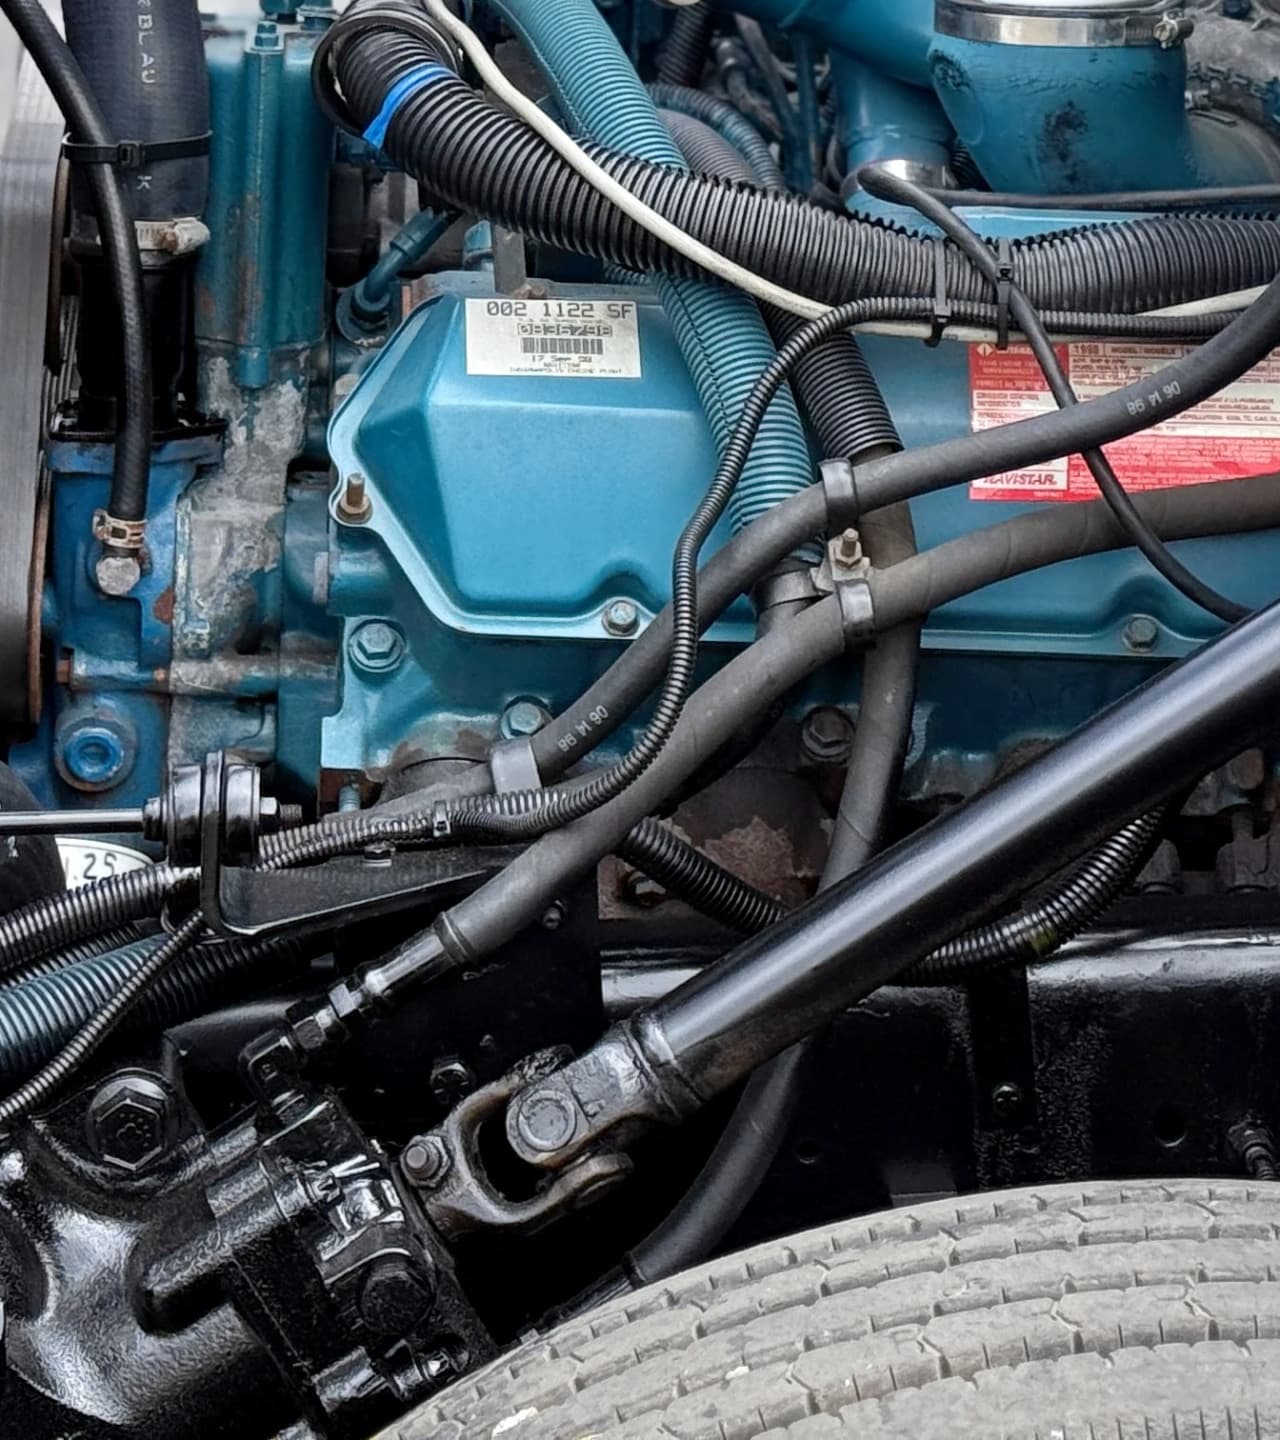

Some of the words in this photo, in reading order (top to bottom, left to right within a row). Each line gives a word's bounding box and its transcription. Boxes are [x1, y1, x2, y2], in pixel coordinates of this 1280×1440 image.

[487, 301, 527, 316] 002
[543, 303, 594, 318] 1122
[607, 303, 634, 319] SF
